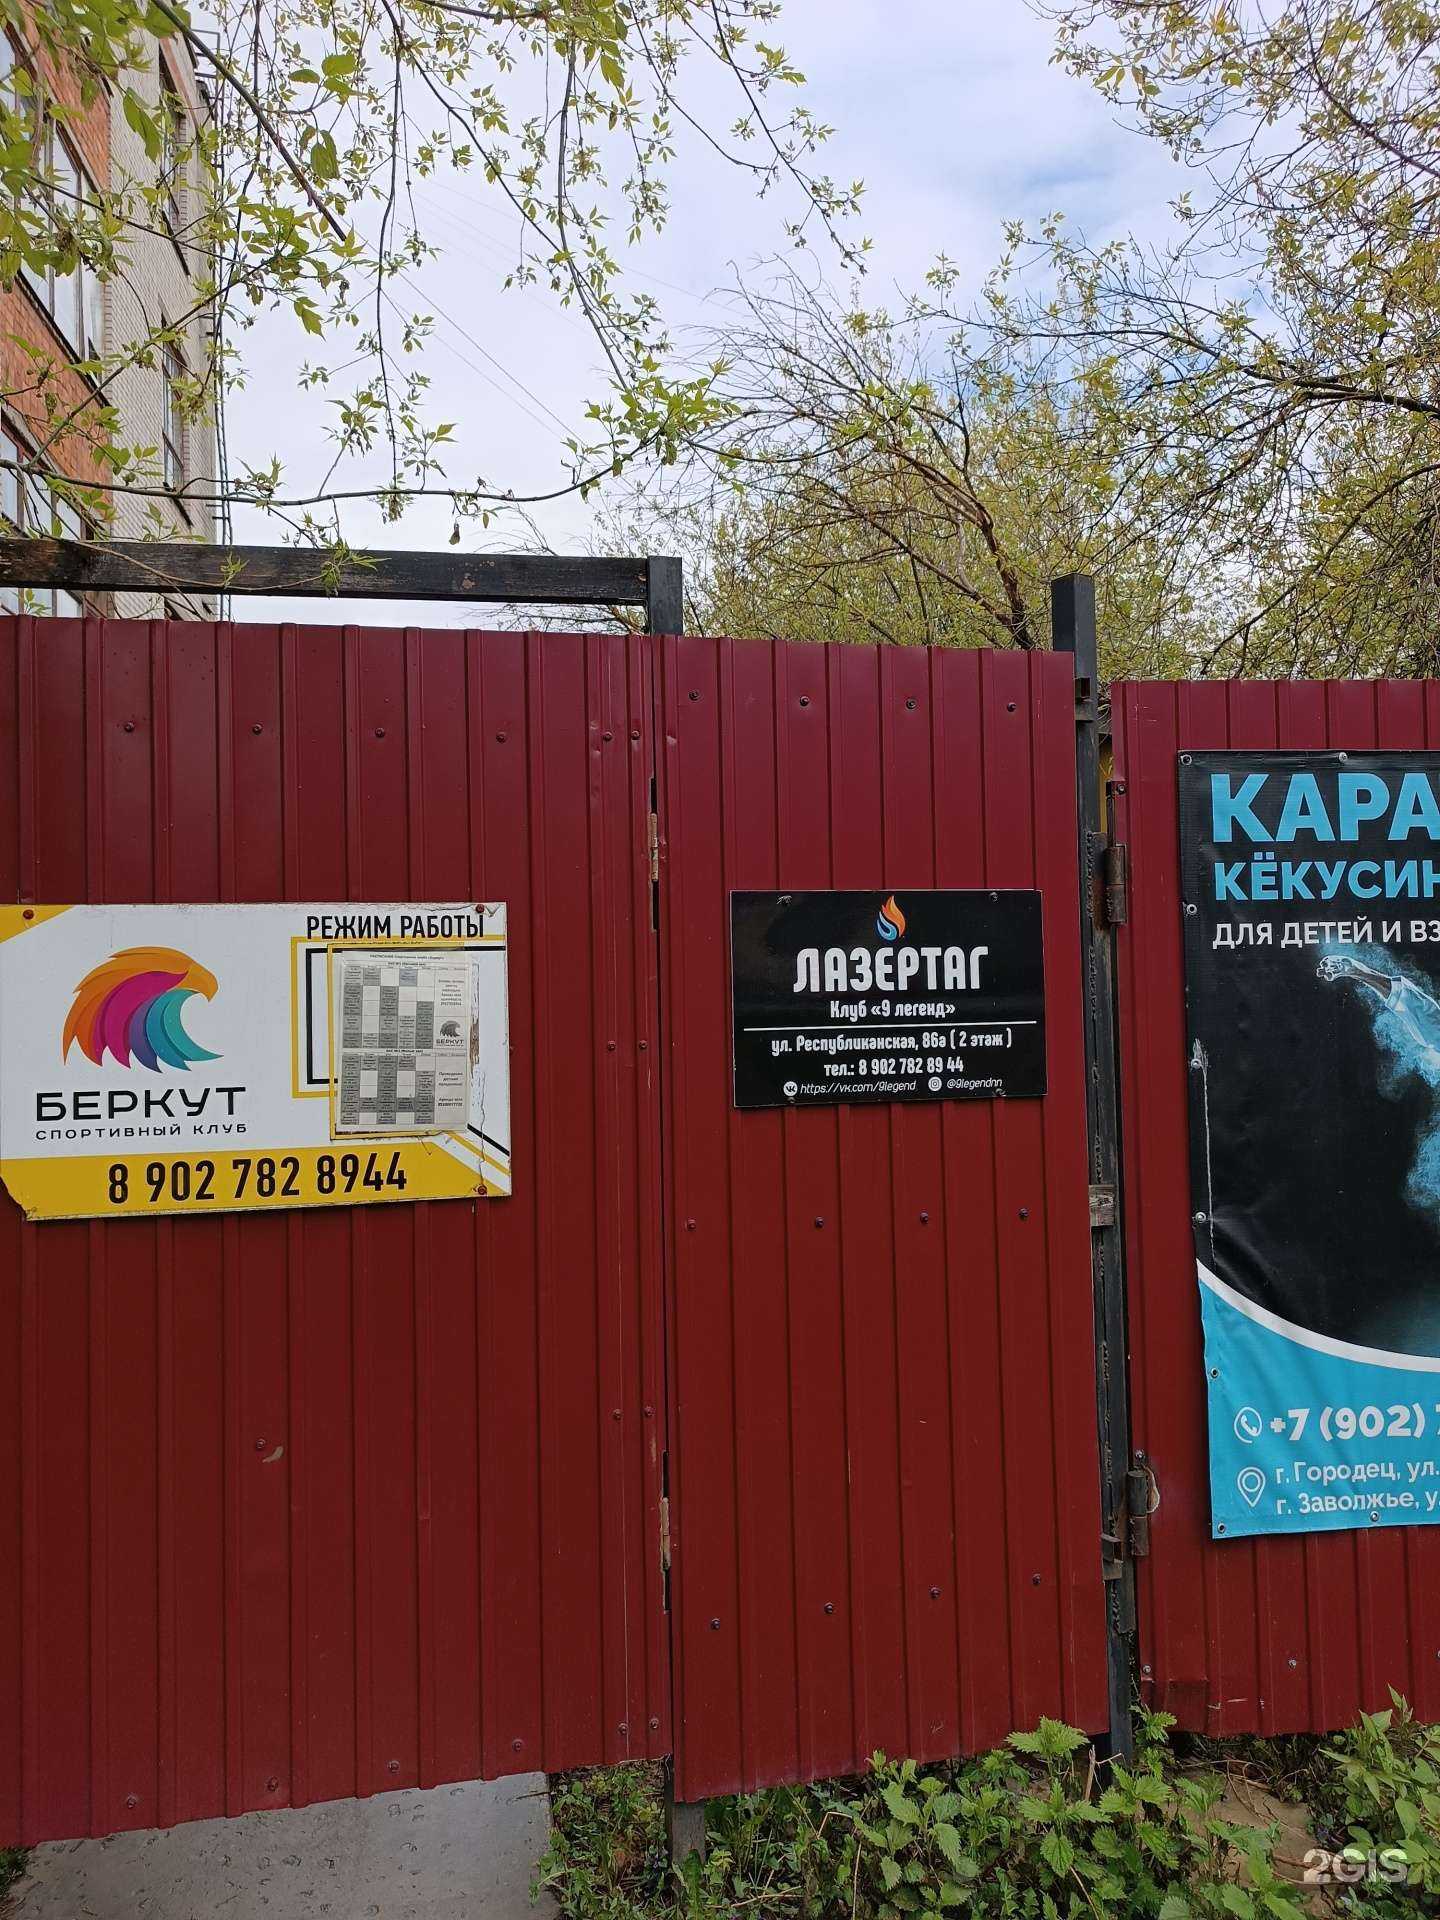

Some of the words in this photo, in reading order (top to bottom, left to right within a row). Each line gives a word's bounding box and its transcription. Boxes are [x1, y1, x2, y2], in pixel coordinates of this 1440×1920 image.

[1210, 772, 1440, 843] КАРА
[1214, 852, 1440, 901] КЁКУСИН
[306, 916, 392, 940] РЕЖИМ
[400, 914, 485, 938] РАБОТЫ
[1212, 923, 1272, 949] ДЛЯ
[1281, 916, 1373, 948] ДЕТЕЙ
[1383, 921, 1401, 943] И
[1410, 920, 1440, 942] ВЗ
[793, 946, 989, 992] ЛАЗЕРТАГ
[830, 1001, 867, 1022] Клуб
[871, 1001, 891, 1017] «9
[895, 1002, 955, 1018] легенд»
[772, 1040, 792, 1056] ул.
[797, 1035, 919, 1054] Республиканская,
[922, 1032, 946, 1048] 86а
[959, 1032, 967, 1047] 2
[971, 1034, 1003, 1047] этаж
[824, 1063, 854, 1077] тел.:
[859, 1061, 867, 1075] 8
[871, 1060, 896, 1075] 902
[900, 1059, 923, 1074] 782
[927, 1057, 943, 1073] 89
[947, 1057, 963, 1073] 44
[36, 1087, 247, 1121] БЕРКУТ
[36, 1123, 181, 1140] СПОРТИВНЫЙ
[193, 1123, 247, 1135] КЛУБ
[108, 1163, 128, 1203] 8
[146, 1160, 215, 1202] 902
[232, 1157, 300, 1198] 782
[316, 1152, 407, 1194] 8944
[1270, 1408, 1310, 1441] +7
[1320, 1403, 1425, 1441] (902)
[1276, 1468, 1289, 1484] г.
[1294, 1462, 1401, 1485] Городец,
[1407, 1461, 1439, 1483] ул.
[1277, 1500, 1292, 1515] г.
[1299, 1491, 1419, 1514] Заволжье,
[1425, 1491, 1440, 1511] у
